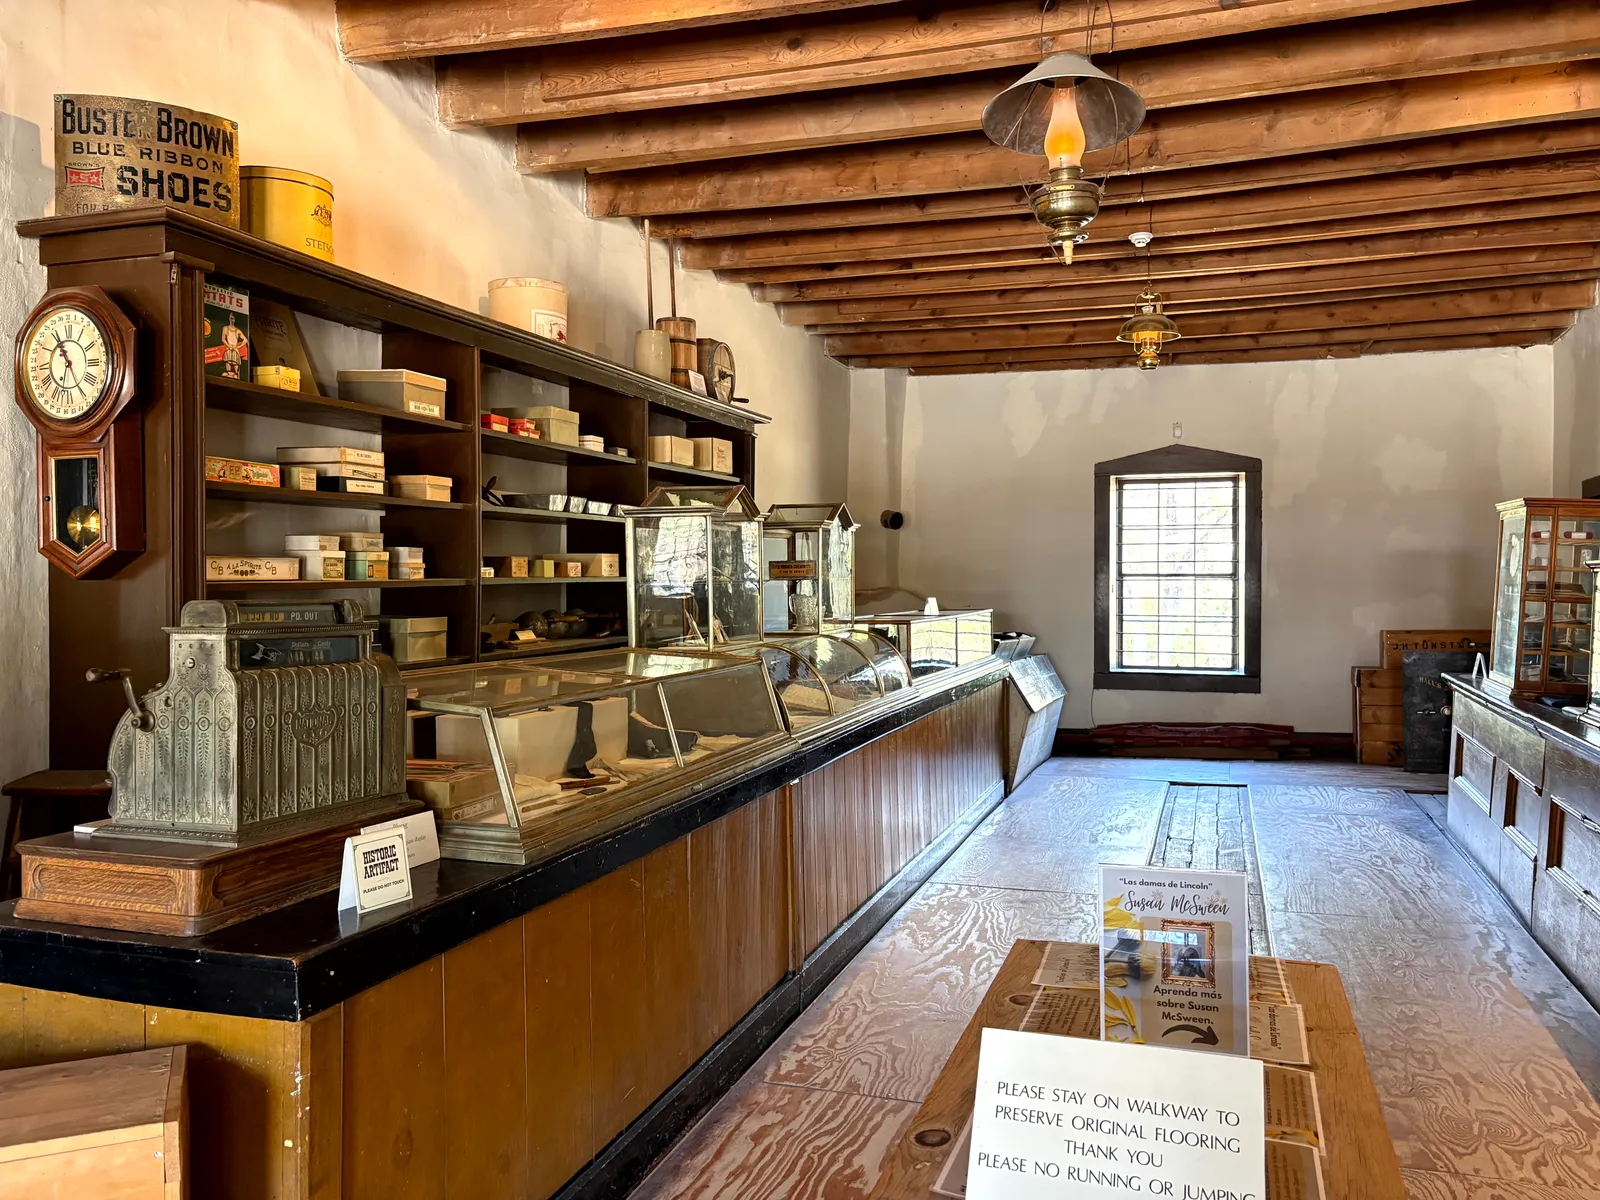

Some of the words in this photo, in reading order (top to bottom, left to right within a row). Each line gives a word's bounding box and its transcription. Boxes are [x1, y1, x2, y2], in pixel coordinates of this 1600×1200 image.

[157, 108, 234, 158] BROWN
[72, 142, 126, 156] BLUE
[140, 147, 223, 174] RIBBON
[116, 165, 232, 212] SHOES
[304, 612, 319, 620] OUT
[363, 845, 397, 864] HISTORIC
[364, 858, 400, 879] ARTIFACT
[363, 886, 377, 894] PLEASE
[1138, 879, 1166, 888] damas
[1124, 890, 1165, 912] Susan
[1170, 894, 1230, 916] McSween
[1153, 985, 1198, 998] Aprenda
[1201, 989, 1222, 999] más
[1157, 1000, 1185, 1009] sobre
[1188, 1001, 1219, 1012] Susan
[1162, 1012, 1214, 1025] McSween.
[997, 1081, 1046, 1100] PLEASE
[1052, 1088, 1087, 1105] STAY
[1094, 1094, 1120, 1110] ON
[1127, 1098, 1208, 1122] WALKWAY
[1216, 1110, 1240, 1127] TO
[995, 1105, 1064, 1128] PRESERVE
[1071, 1115, 1147, 1140] ORIGINAL
[1155, 1128, 1241, 1153] FLOORING
[1064, 1140, 1118, 1161] THANK
[1127, 1149, 1164, 1168] YOU
[978, 1152, 1027, 1173] PLEASE
[1034, 1161, 1060, 1178] NO
[1067, 1166, 1142, 1192] RUNNING
[1149, 1179, 1174, 1197] OR
